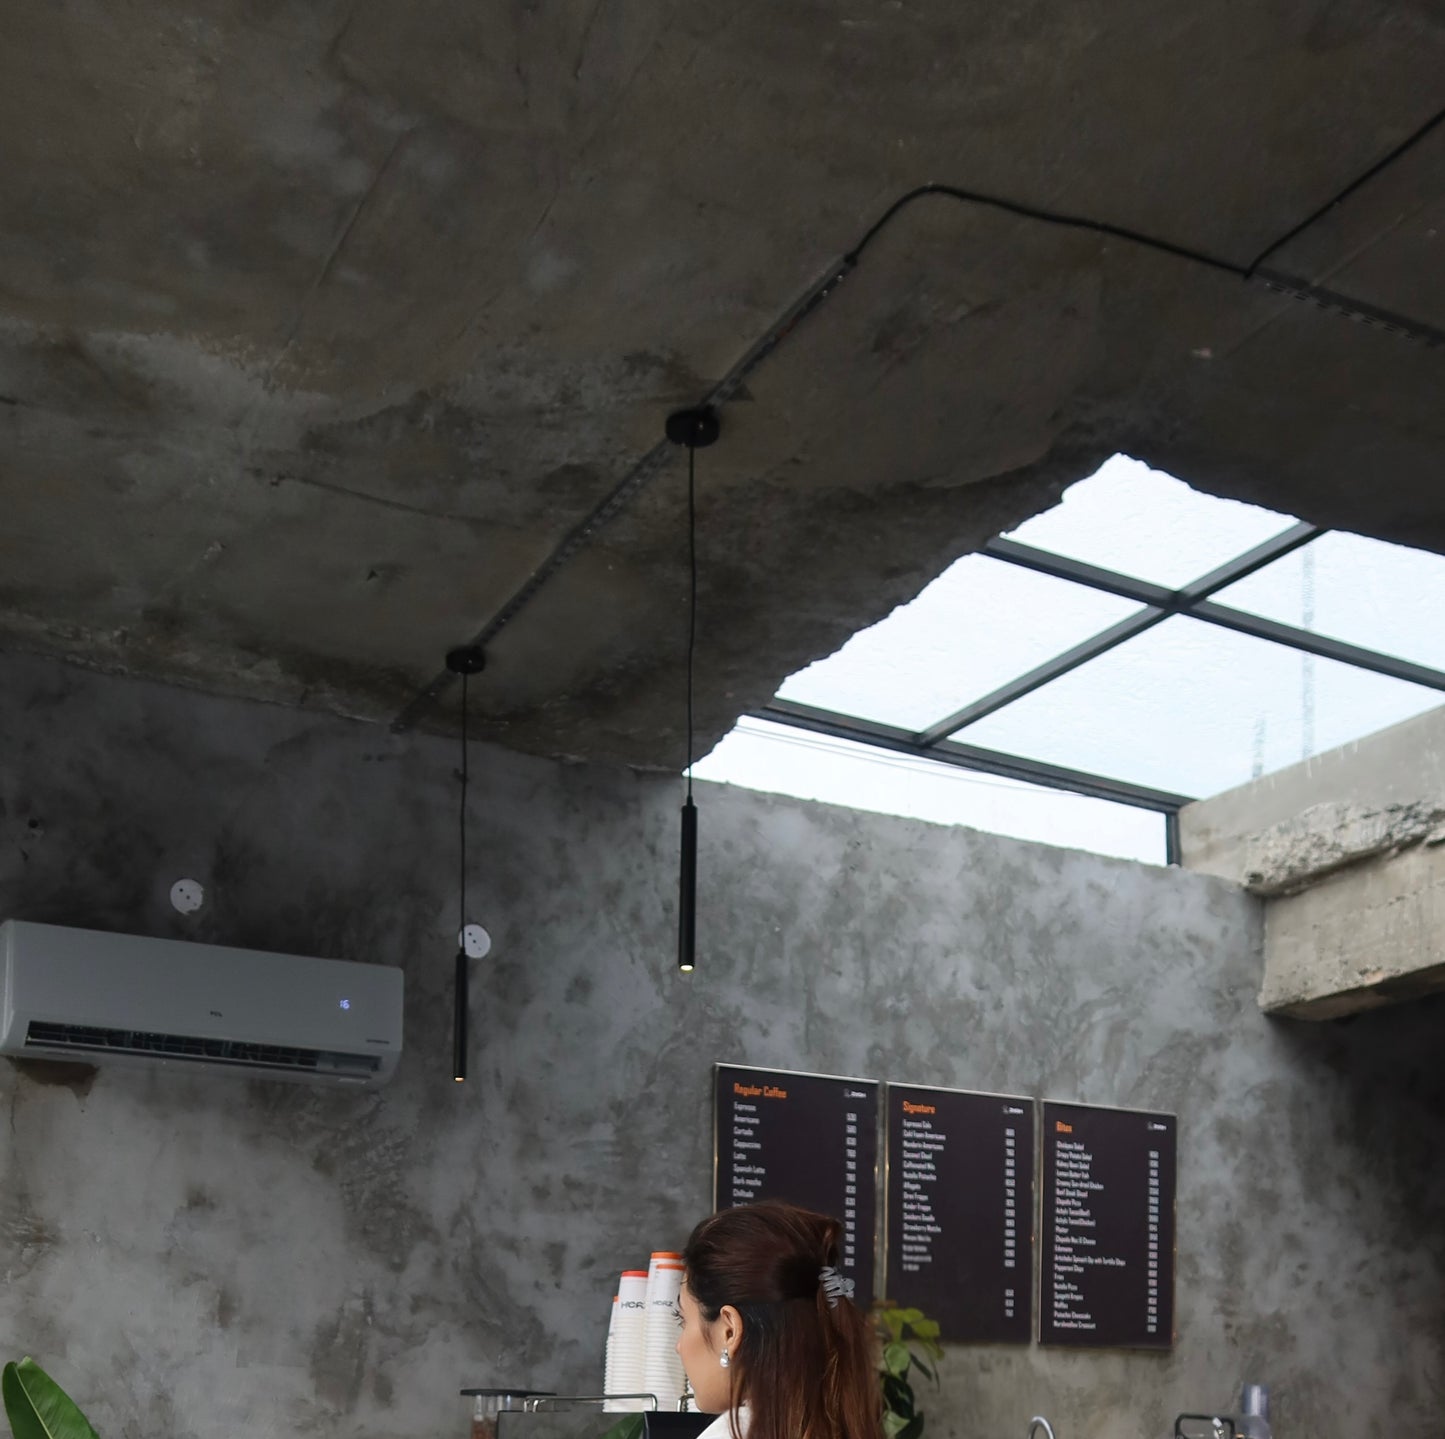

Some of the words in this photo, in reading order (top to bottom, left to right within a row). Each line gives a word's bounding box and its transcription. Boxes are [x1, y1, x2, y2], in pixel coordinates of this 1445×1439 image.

[734, 1083, 762, 1096] Regular
[763, 1086, 787, 1098] Coffee
[903, 1101, 936, 1114] Signature
[1056, 1121, 1072, 1133] Bites
